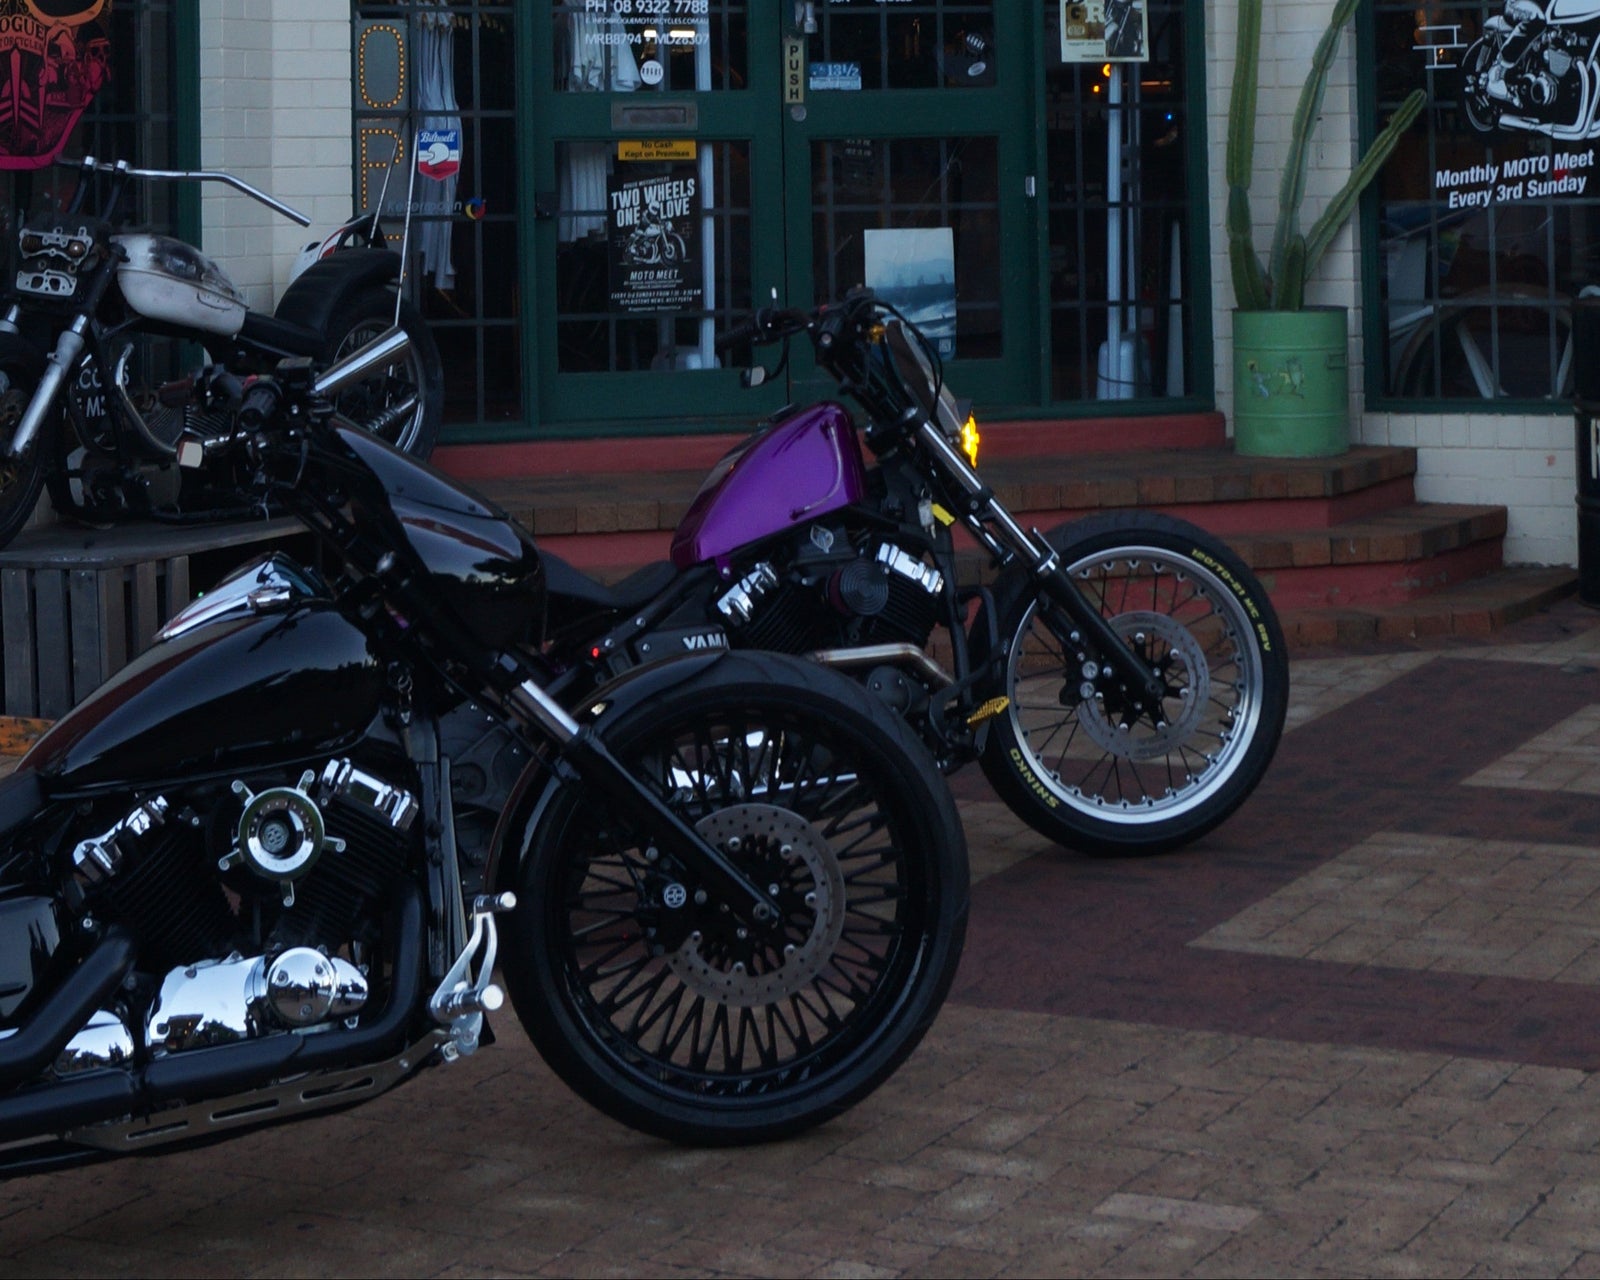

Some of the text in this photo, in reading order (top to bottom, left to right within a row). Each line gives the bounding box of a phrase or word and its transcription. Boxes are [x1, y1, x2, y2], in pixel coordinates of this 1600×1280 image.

[585, 0, 709, 13] PH 08 9322 7788
[789, 45, 800, 99] PUSH
[641, 140, 674, 149] No Cash
[1435, 148, 1595, 188] Monthly MOTO Meet
[611, 177, 696, 211] TWO WHEELS
[1449, 175, 1587, 209] Every 3rd Sunday
[616, 197, 691, 229] ONE LOVE
[630, 268, 680, 281] MOTO MEET
[1010, 748, 1060, 809] SHINKO
